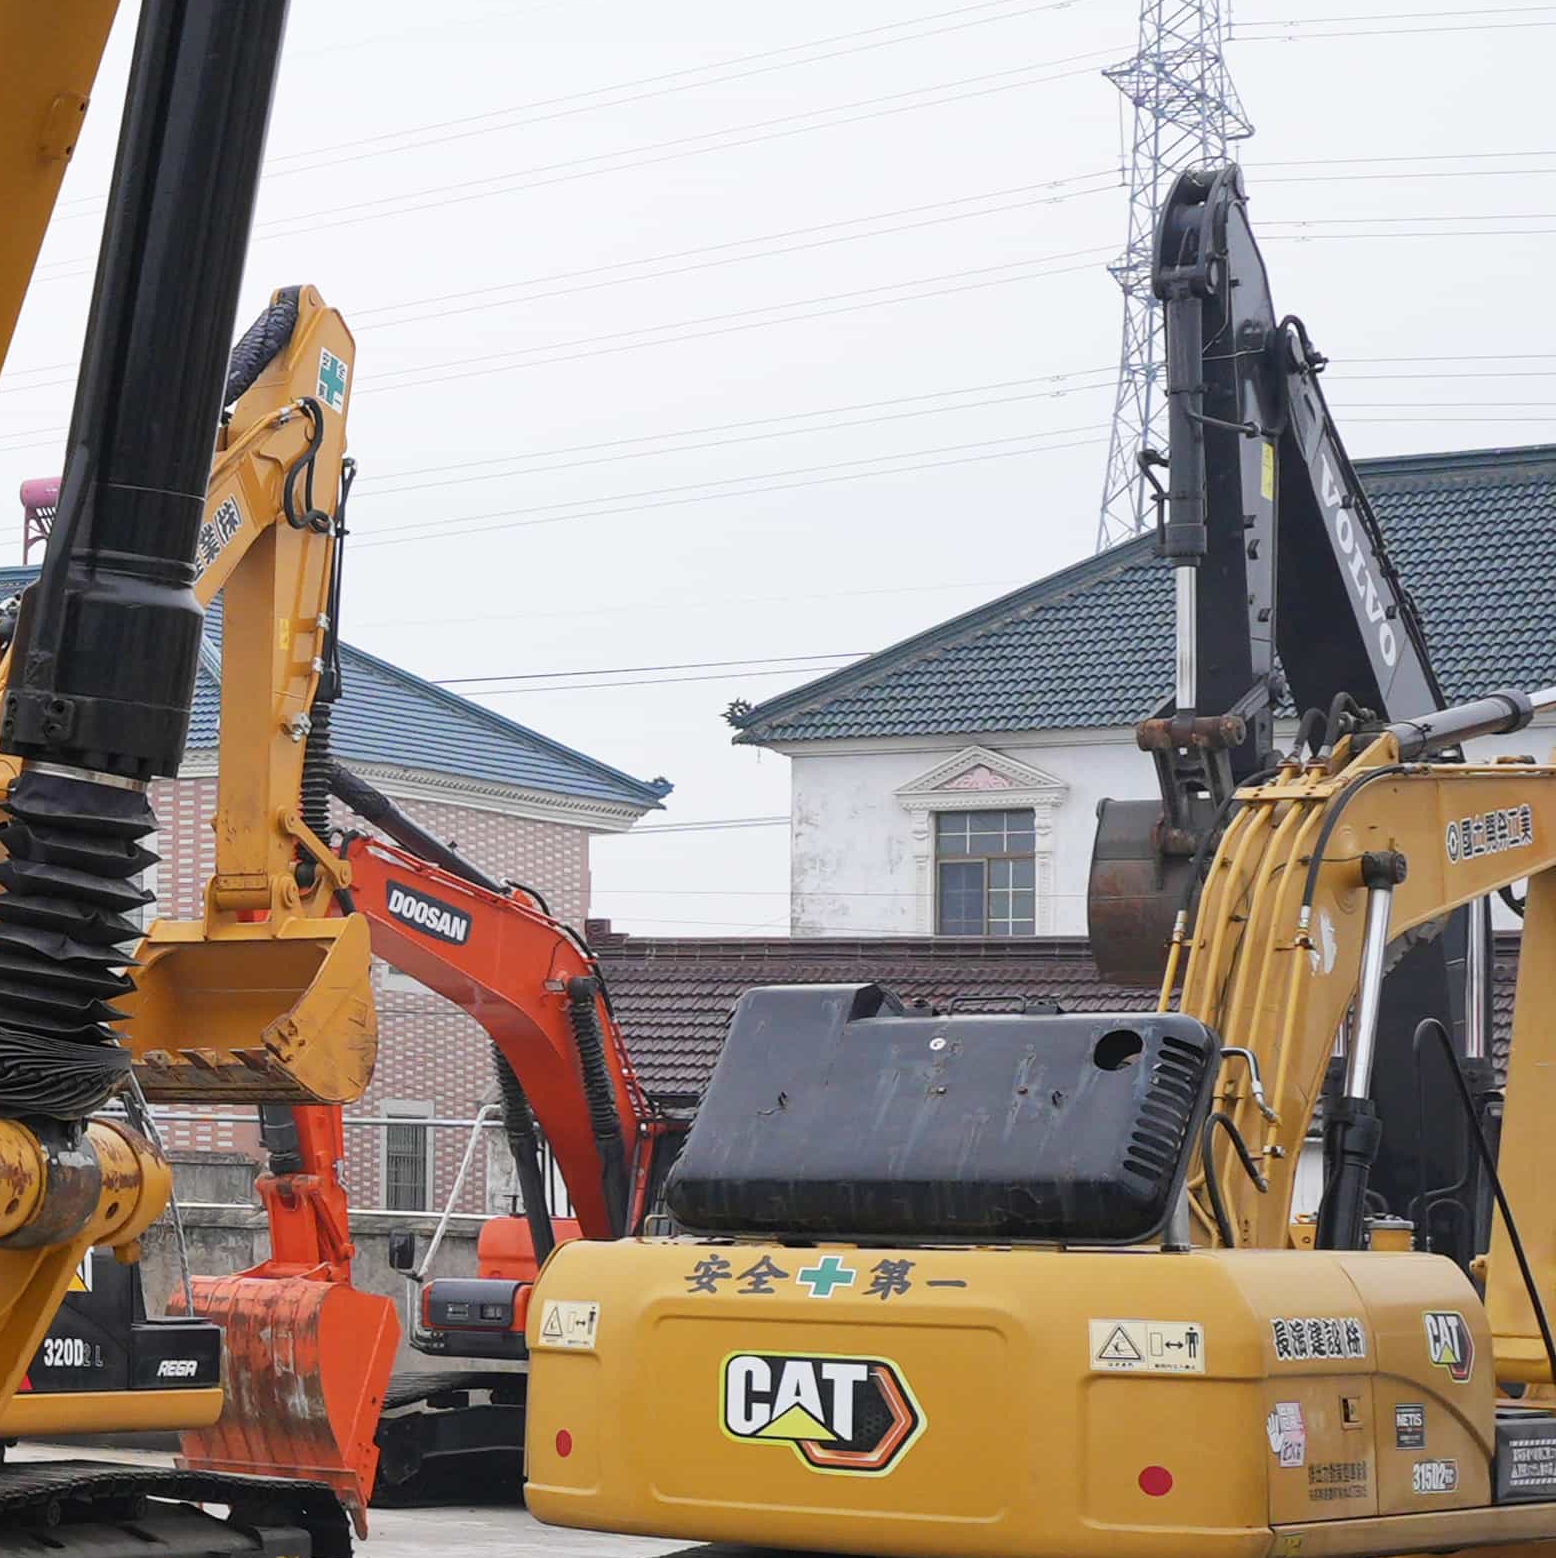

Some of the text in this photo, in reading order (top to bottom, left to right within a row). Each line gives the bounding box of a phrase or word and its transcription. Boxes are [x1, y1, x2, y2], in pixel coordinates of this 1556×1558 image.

[1322, 453, 1396, 667] VOLVO
[387, 888, 468, 942] DOOSAN
[1425, 1314, 1460, 1362] CAT
[727, 1356, 868, 1442] CAT
[1396, 1414, 1422, 1427] NETIS
